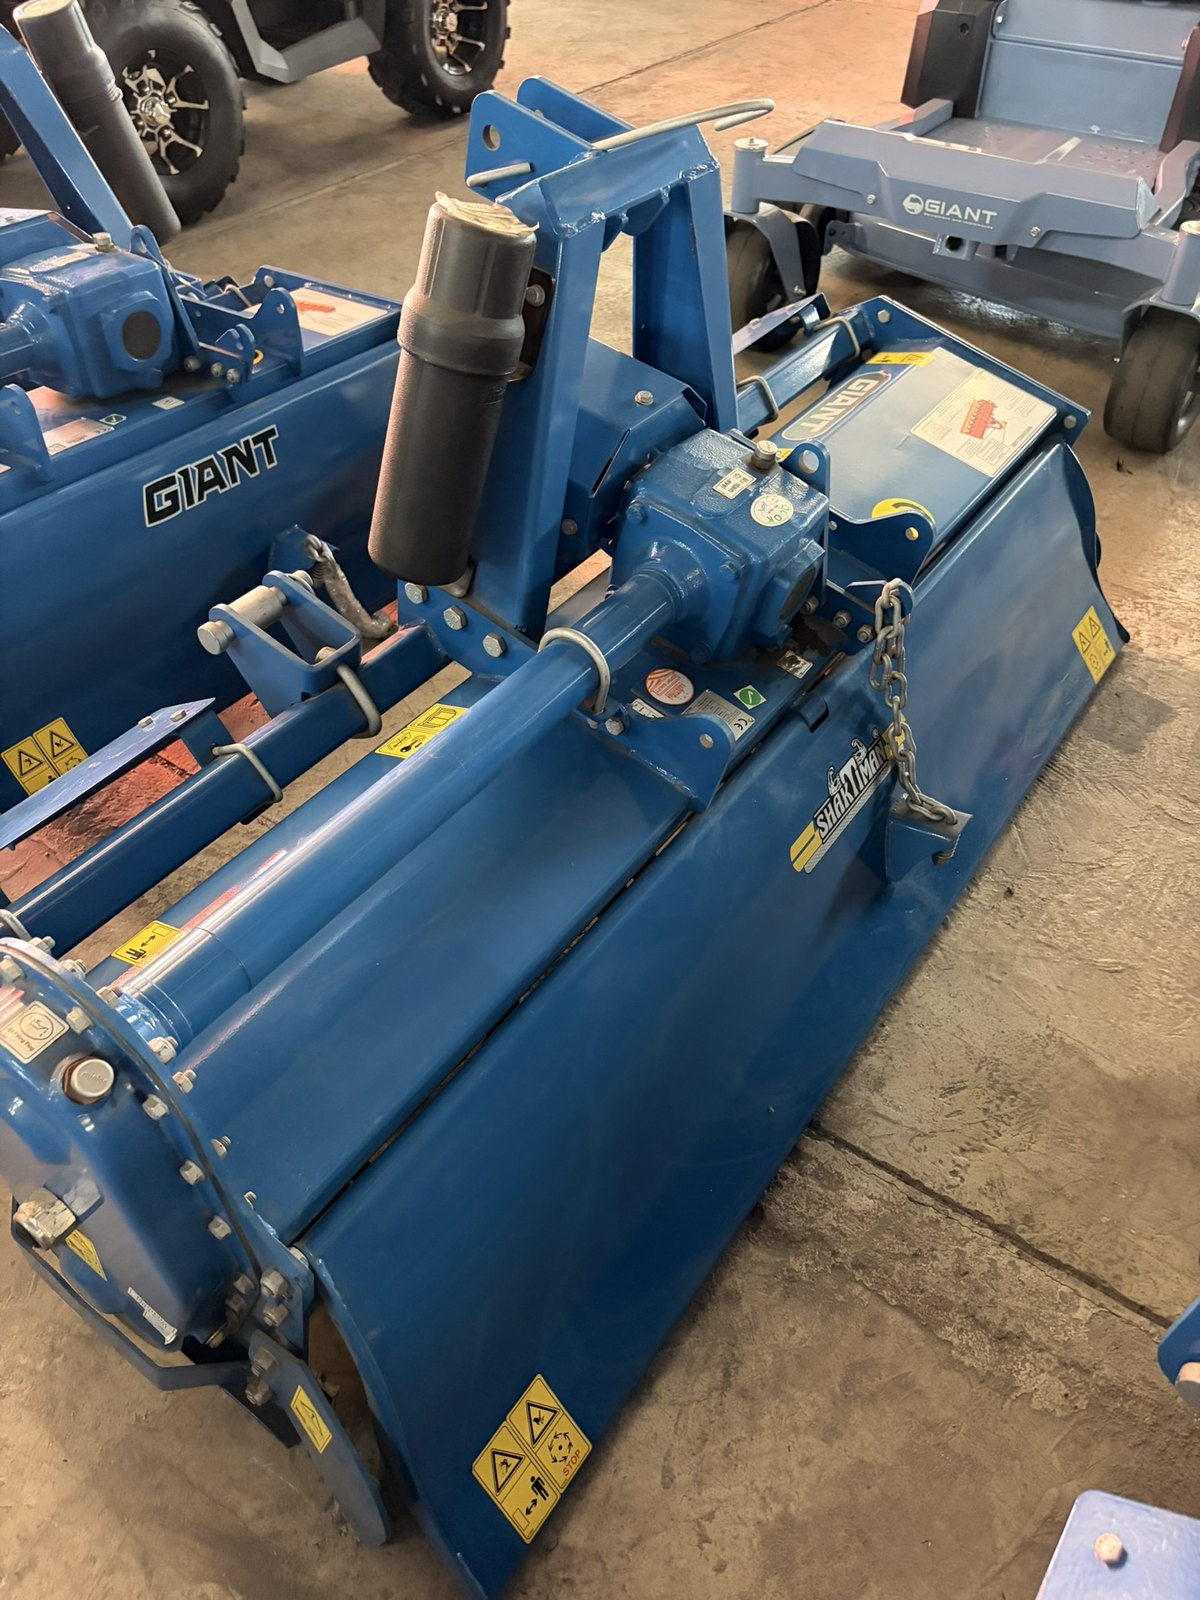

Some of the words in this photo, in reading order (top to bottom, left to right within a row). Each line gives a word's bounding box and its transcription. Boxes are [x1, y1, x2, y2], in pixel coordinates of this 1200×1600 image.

[925, 199, 998, 225] GIANT
[800, 378, 880, 433] GIANT
[142, 423, 280, 528] GIANT
[816, 739, 888, 839] SHAKTIMAN
[562, 1449, 581, 1477] STOP
